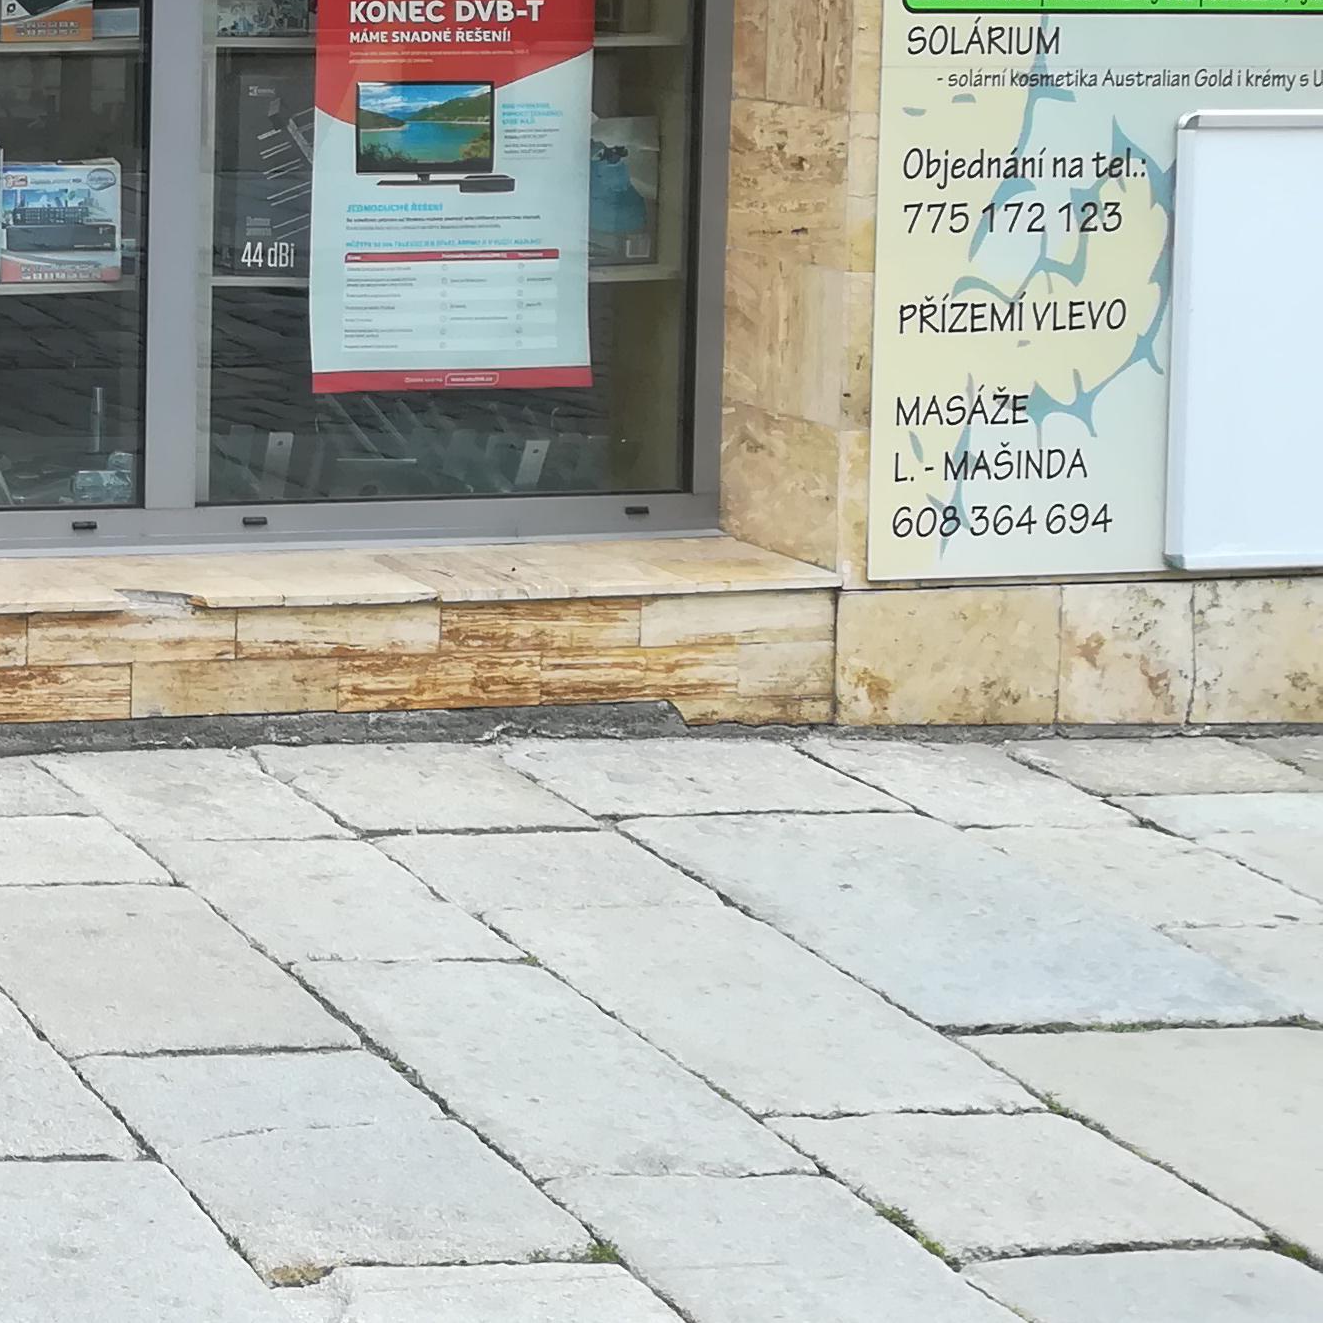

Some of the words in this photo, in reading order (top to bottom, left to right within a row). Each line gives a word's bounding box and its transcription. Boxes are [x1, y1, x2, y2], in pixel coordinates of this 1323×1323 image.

[349, 0, 446, 24] KONEC
[455, 0, 545, 23] DVB-T
[349, 27, 389, 44] MÁME
[391, 27, 452, 43] SNADNÉ
[455, 26, 511, 43] ŘEŠENÍ!
[906, 15, 1061, 57] SOLÁRIUM
[947, 68, 1008, 88] solární
[1010, 69, 1098, 88] kosmetika
[1102, 68, 1191, 88] Australian
[1193, 68, 1233, 88] Gold
[1235, 69, 1242, 87] i
[1244, 68, 1297, 93] krémy
[1299, 74, 1310, 88] s
[902, 147, 1047, 191] Objednání
[1052, 153, 1084, 179] na
[1092, 149, 1148, 179] tel.:
[902, 201, 970, 235] 775
[982, 201, 1047, 234] 172
[1057, 201, 1124, 234] 123
[241, 241, 264, 268] 44
[267, 241, 296, 268] dBi
[898, 291, 1028, 335] PŘÍZEMÍ
[1032, 297, 1127, 332] VLEVO
[895, 384, 1030, 427] MASÁŽE
[894, 451, 916, 483] L.
[943, 441, 1089, 481] MAŠINDA
[891, 505, 962, 539] 608
[968, 504, 1038, 537] 364
[1044, 503, 1114, 536] 694
